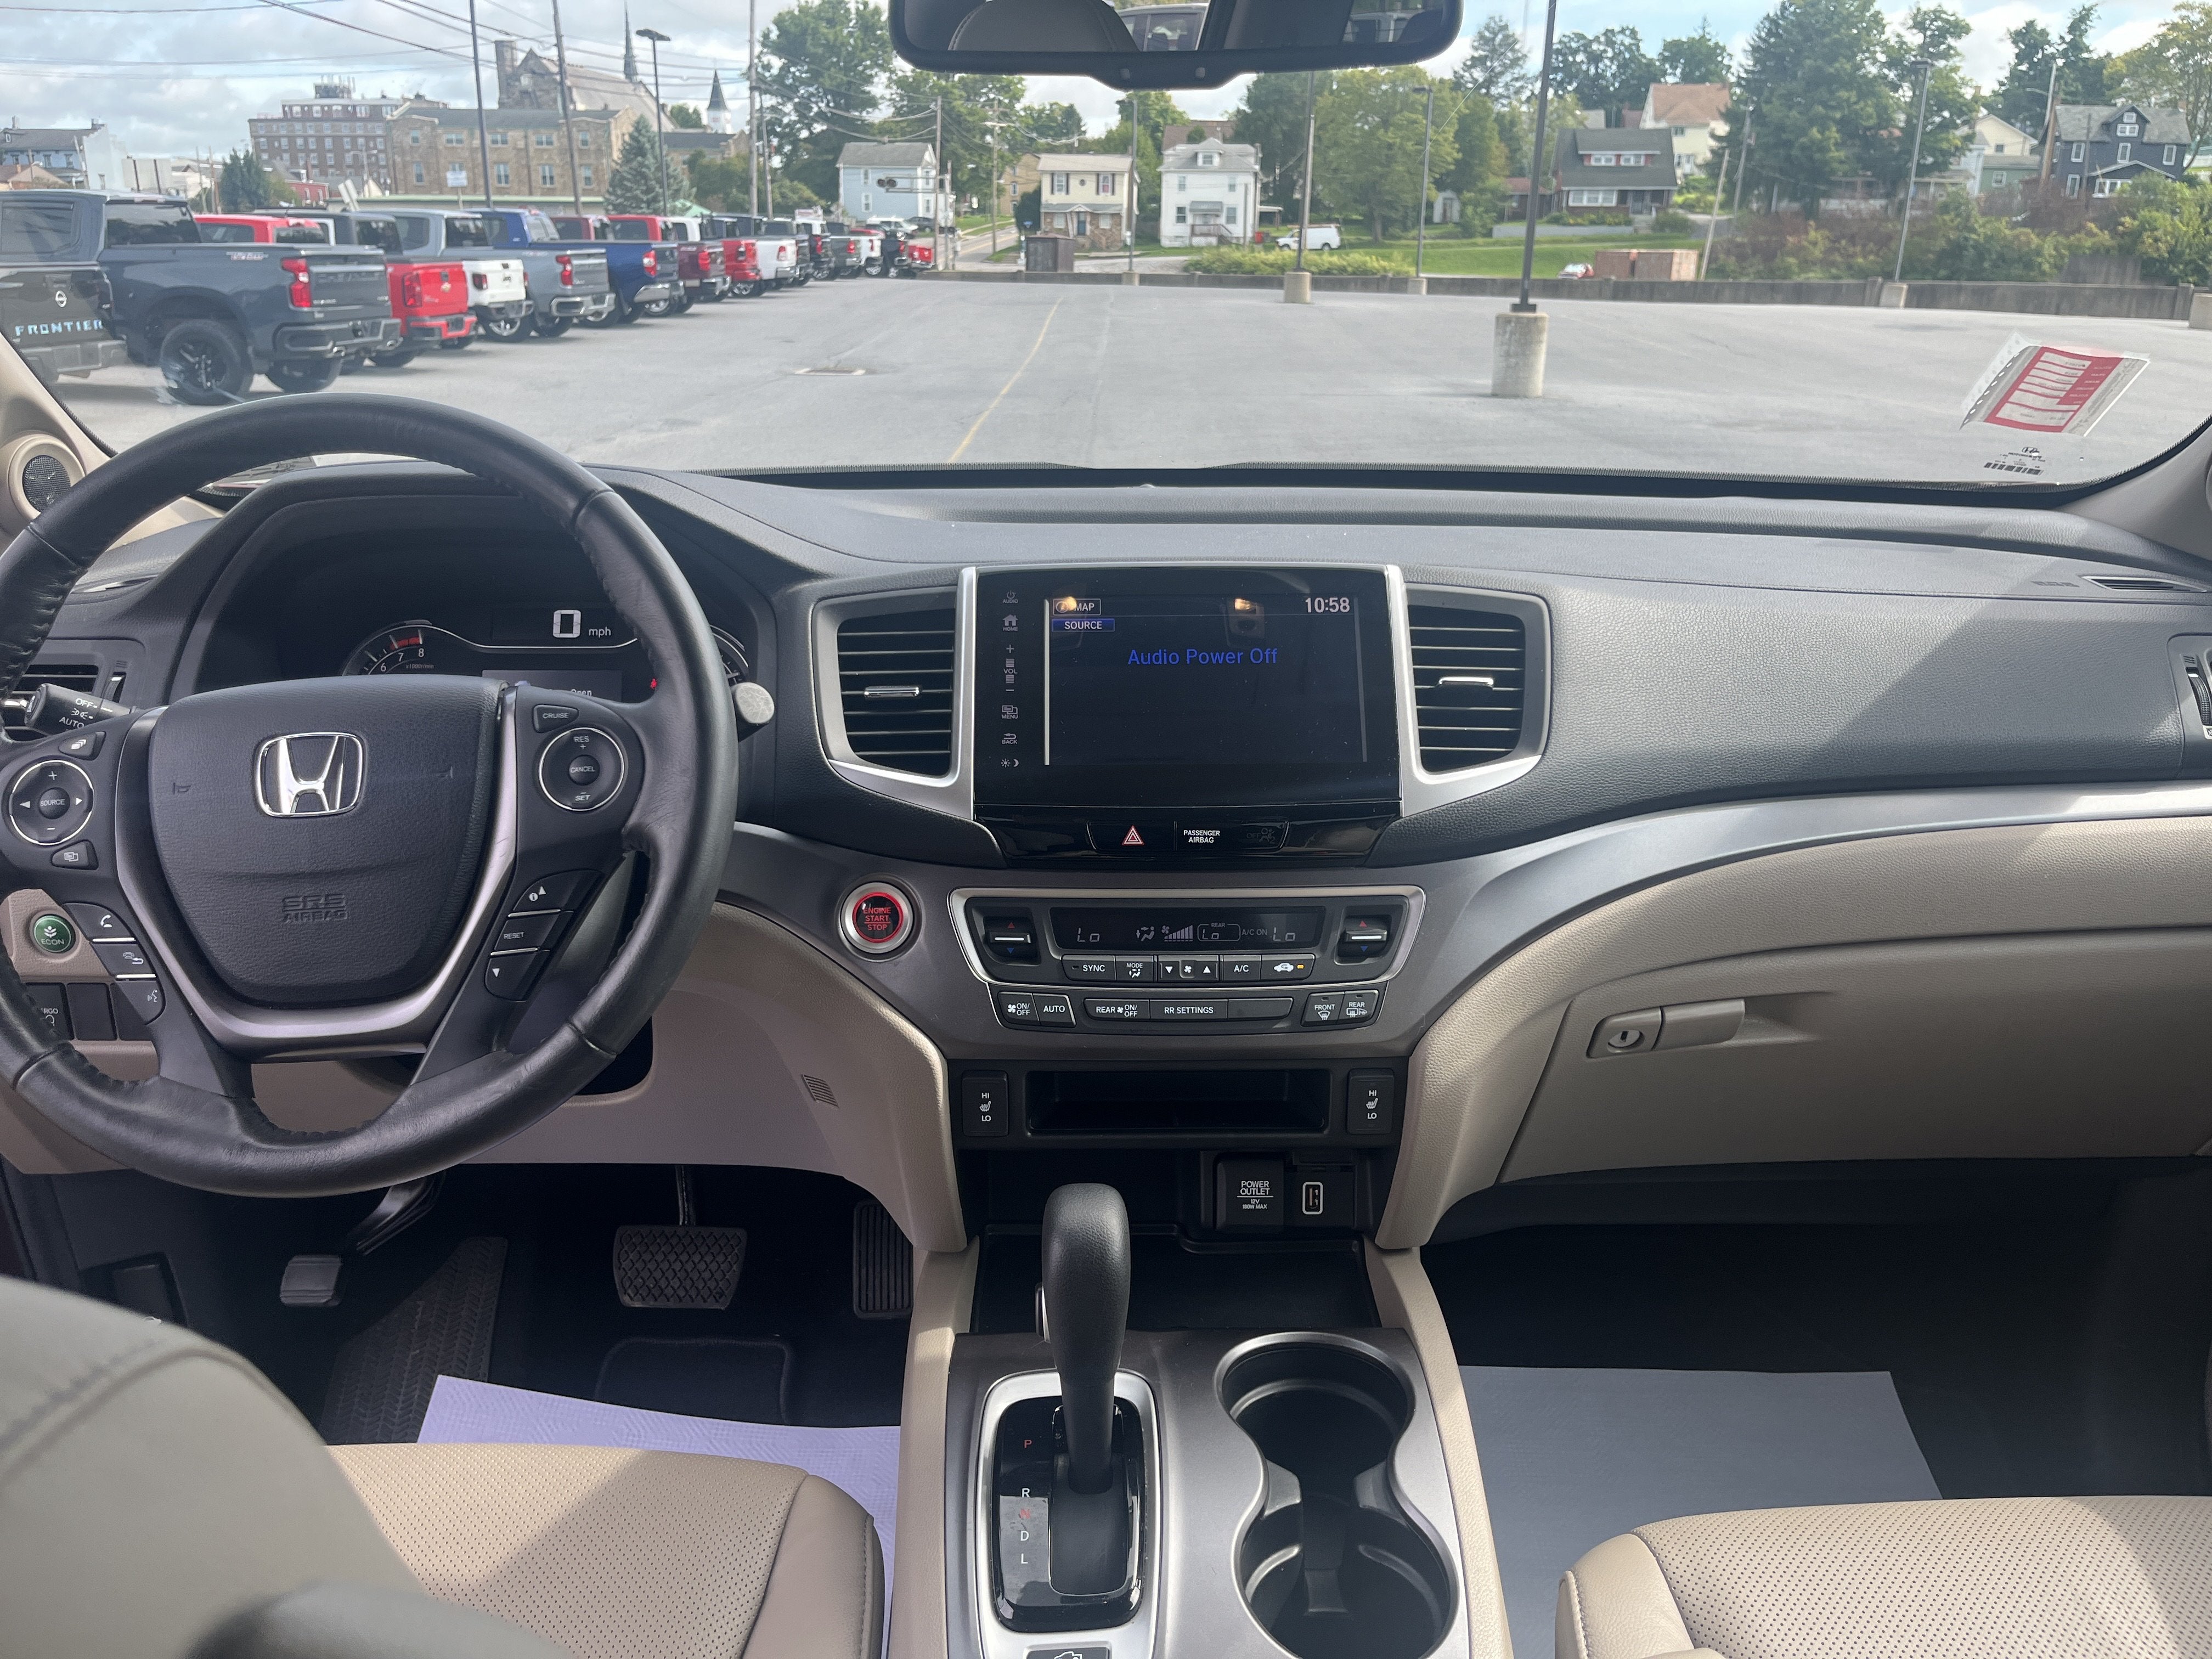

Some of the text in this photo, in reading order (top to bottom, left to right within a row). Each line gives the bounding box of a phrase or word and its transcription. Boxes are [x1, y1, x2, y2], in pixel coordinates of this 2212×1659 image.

[15, 319, 104, 336] FRONTIER
[1074, 602, 1095, 612] MAP
[1305, 597, 1351, 613] 10:58
[552, 610, 611, 638] 0 mph
[1064, 621, 1103, 630] SOURCE
[398, 652, 404, 662] 7
[418, 648, 424, 657] 8
[1128, 648, 1278, 665] Audio Power Off
[380, 662, 387, 672] 6
[76, 698, 94, 708] OFF
[59, 716, 84, 729] AUTO
[40, 798, 65, 806] SOURCE
[282, 893, 346, 910] SRS
[41, 938, 65, 946] ECON
[1082, 964, 1105, 973] SYNC
[1233, 964, 1249, 973] A/C
[1043, 1005, 1065, 1013] AUTO
[1176, 1006, 1214, 1014] SETTINGS
[1024, 1440, 1032, 1448] P
[1022, 1488, 1030, 1498] R
[1020, 1509, 1030, 1519] N
[1020, 1531, 1030, 1541] D
[1021, 1553, 1028, 1564] L
